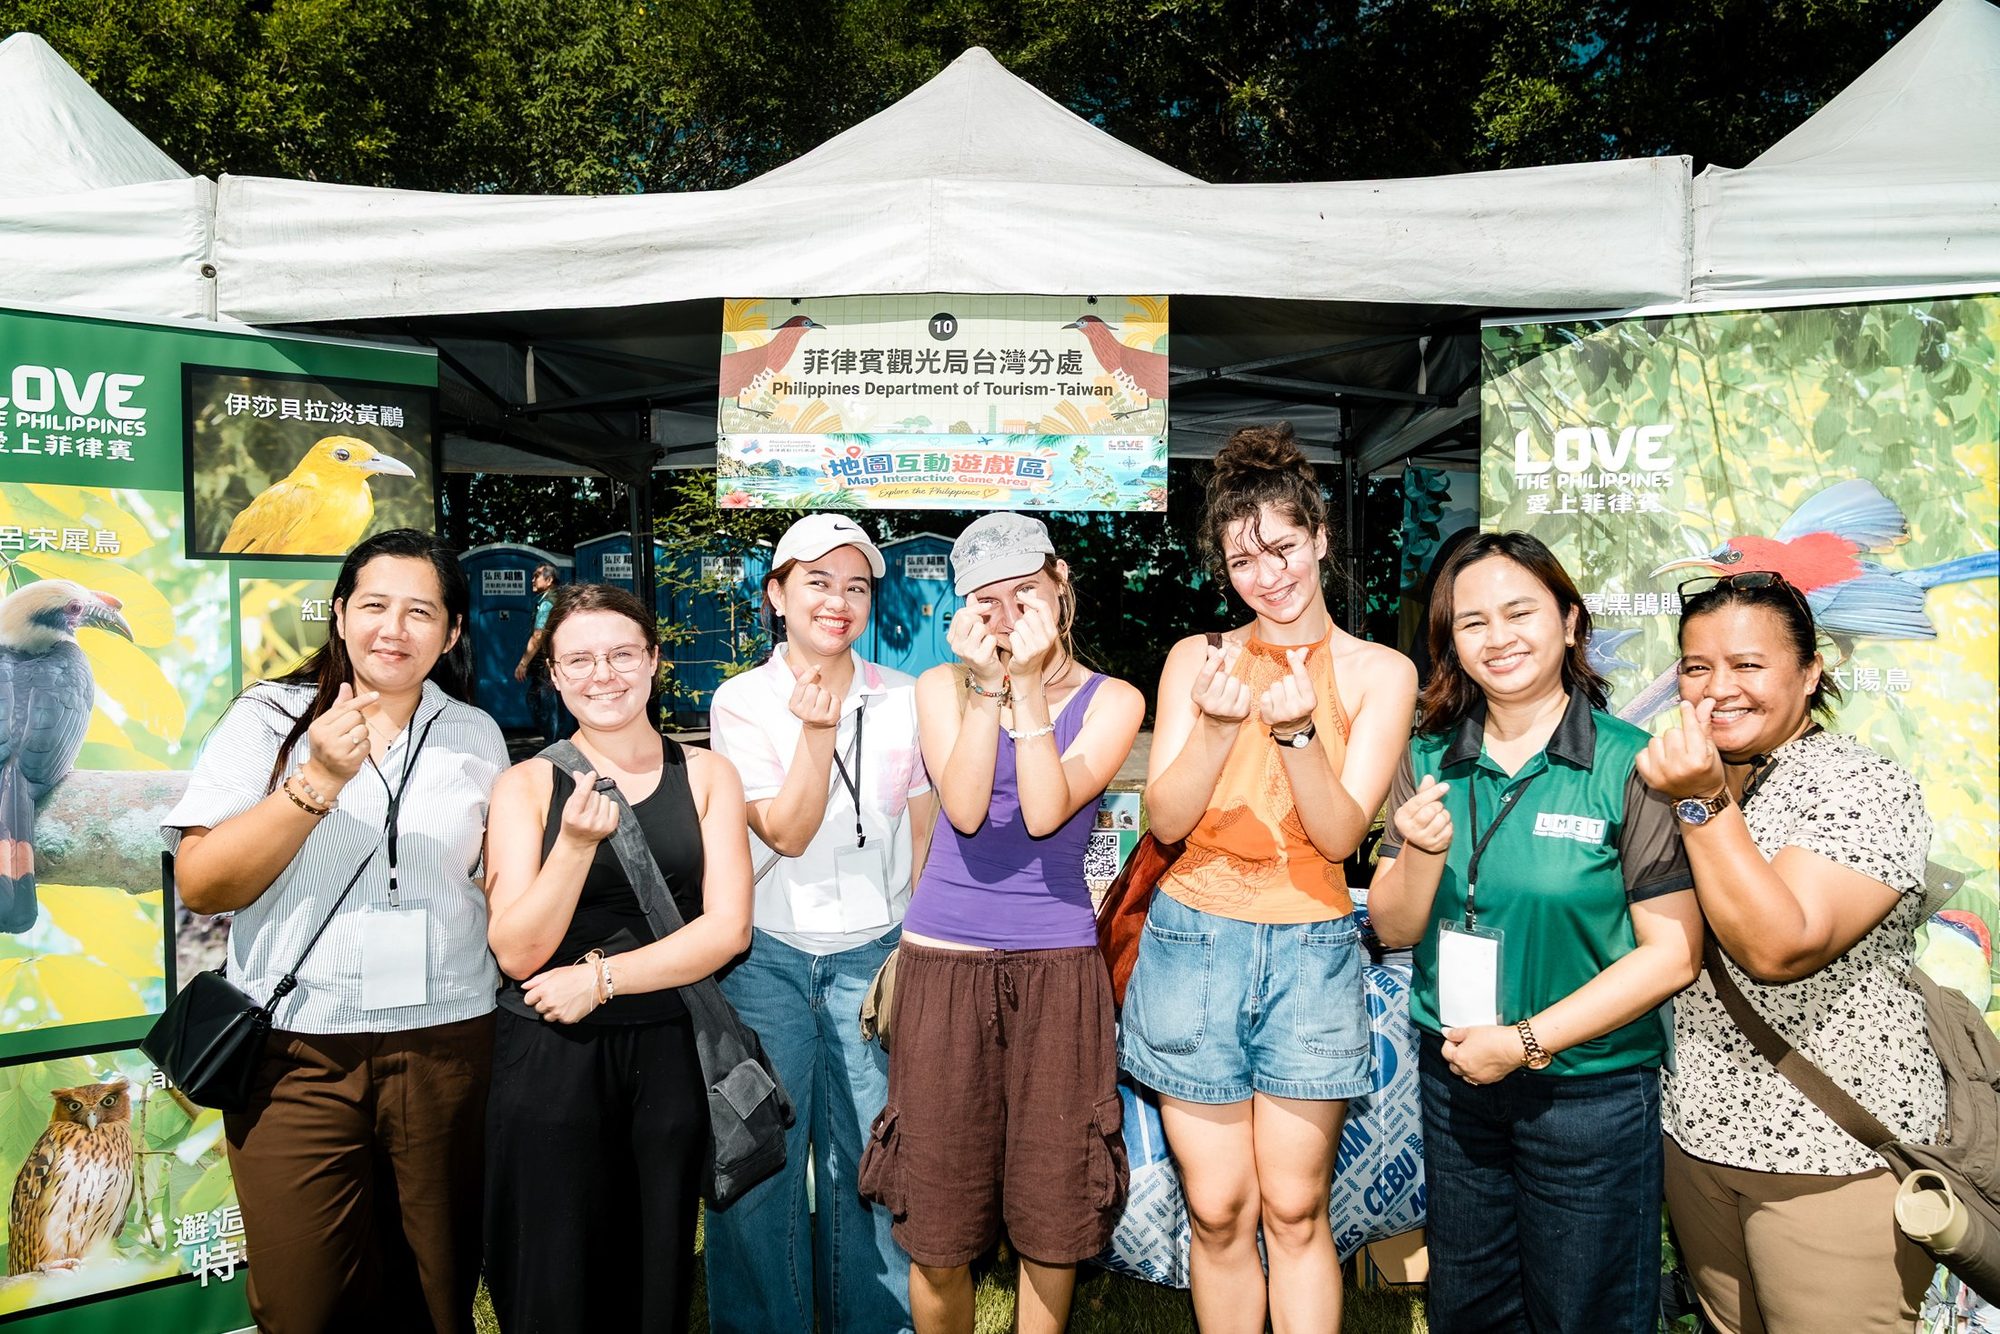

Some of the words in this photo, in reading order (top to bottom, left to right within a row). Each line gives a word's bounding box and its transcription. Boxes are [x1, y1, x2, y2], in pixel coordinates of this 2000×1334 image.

[934, 320, 953, 334] 10
[803, 348, 1083, 375] 菲律賓觀光局台灣分處
[0, 365, 147, 420] OVE
[772, 382, 860, 398] Philippines
[864, 382, 958, 398] Department
[963, 382, 980, 395] of
[984, 382, 1113, 396] Tourism-Taiwan
[224, 392, 405, 428] 伊莎貝拉淡黃鸝
[16, 412, 147, 437] PHILIPPINES
[1515, 424, 1675, 474] LOVE
[828, 453, 1047, 479] 地圖互動遊戲區
[847, 476, 879, 486] Map
[882, 474, 954, 483] Interactive
[958, 475, 994, 484] Game
[999, 476, 1028, 486] Area
[878, 488, 909, 498] Explore
[912, 487, 926, 495] the
[928, 487, 981, 498] Philippines
[1516, 473, 1550, 490] THE
[1557, 471, 1674, 489] PHILIPPINES
[1526, 492, 1662, 514] 愛上菲律賓
[0, 525, 121, 555] 呂宋犀鳥
[301, 598, 333, 621] 紅
[1363, 1147, 1418, 1217] CEBU
[172, 1204, 247, 1250] 邂逅
[191, 1239, 249, 1288] 特
